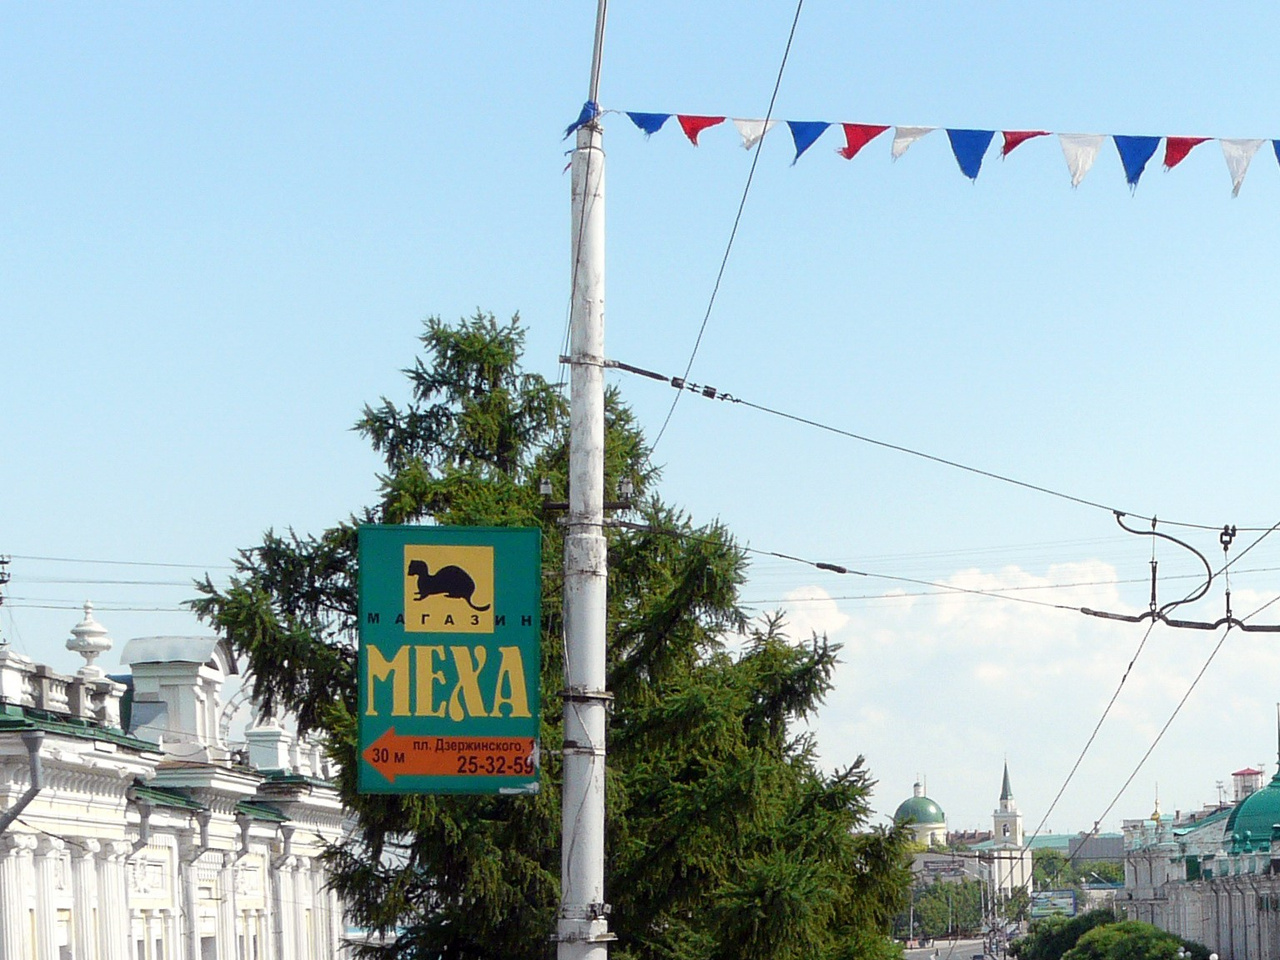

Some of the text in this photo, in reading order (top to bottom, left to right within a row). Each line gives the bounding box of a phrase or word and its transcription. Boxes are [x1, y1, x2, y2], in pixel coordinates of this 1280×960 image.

[367, 612, 533, 627] МАГАЗИН
[365, 643, 533, 722] МЕХА
[413, 741, 432, 751] пл.
[435, 739, 525, 754] Дзержинского,
[372, 747, 405, 764] 30 м
[457, 756, 535, 775] 25-32-59
